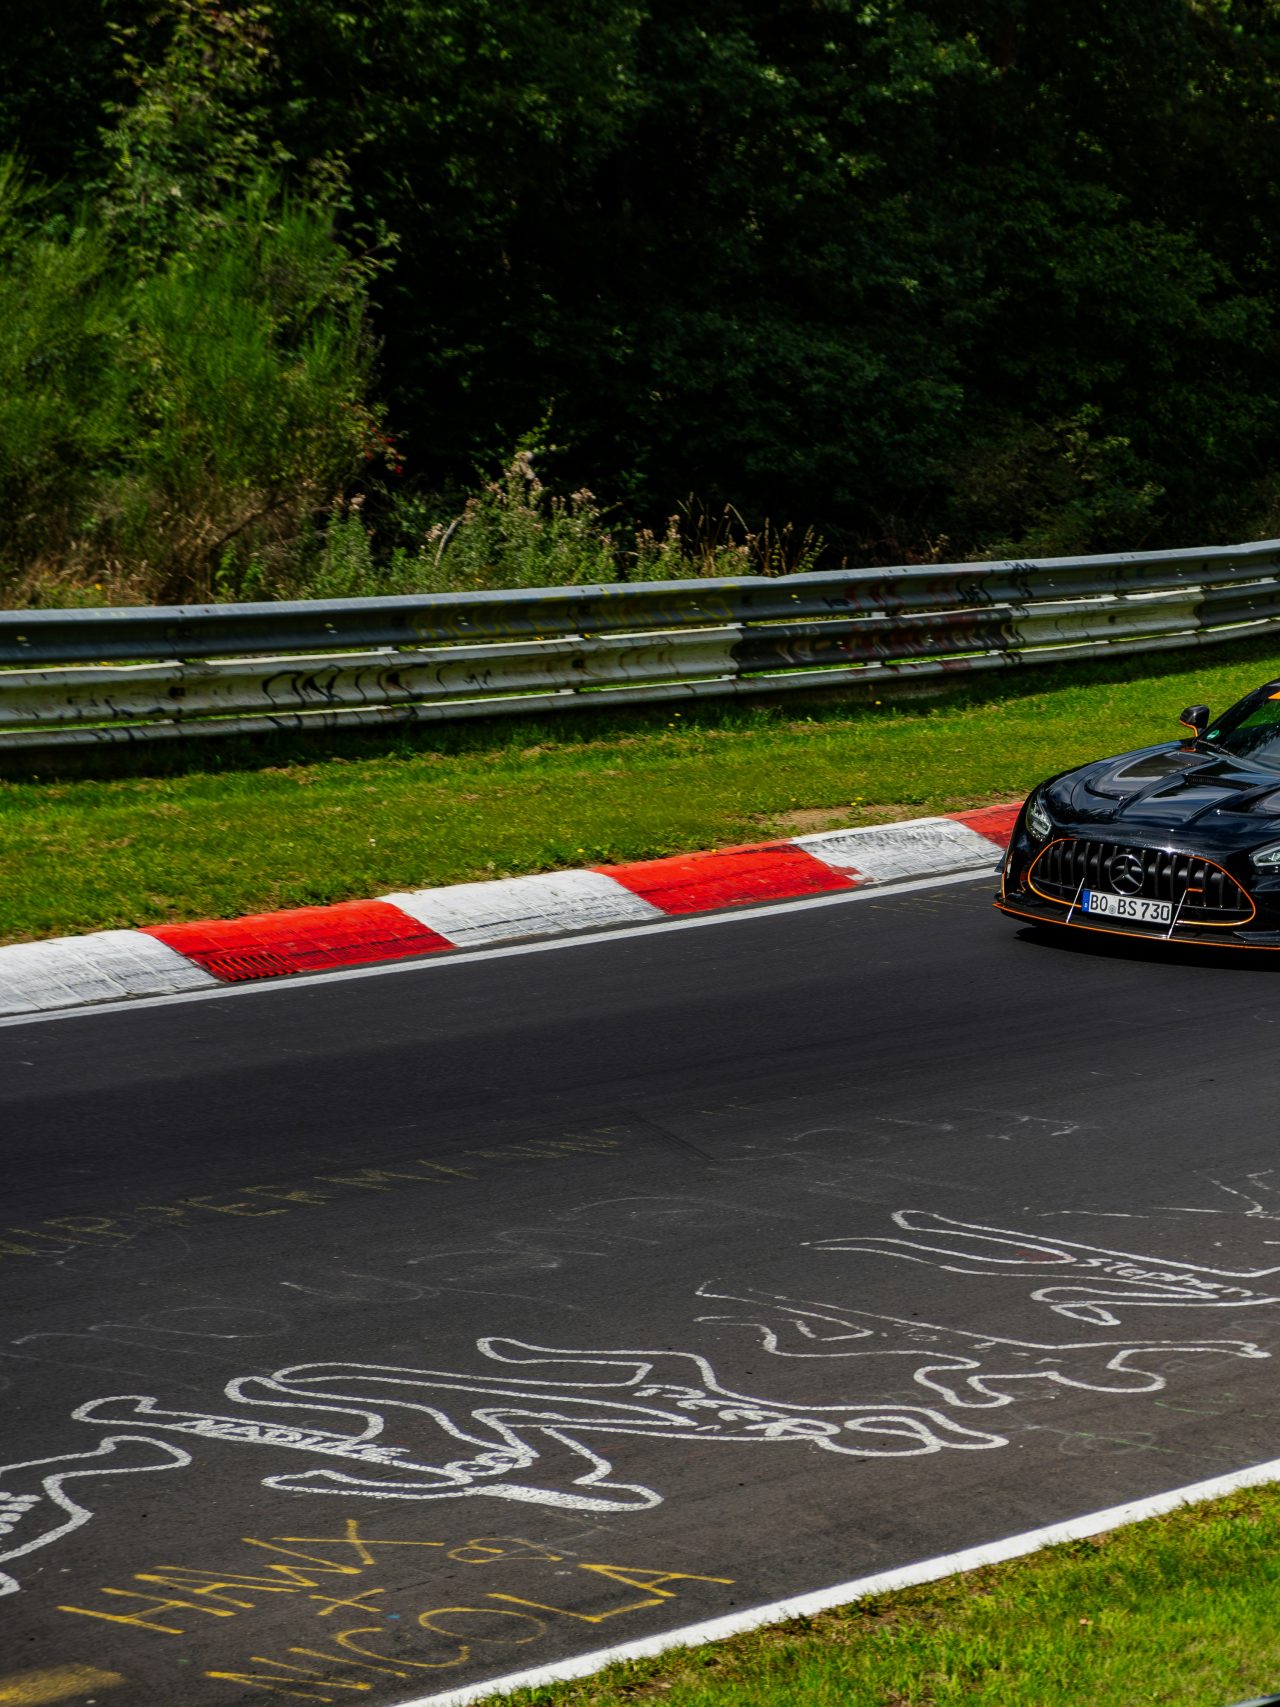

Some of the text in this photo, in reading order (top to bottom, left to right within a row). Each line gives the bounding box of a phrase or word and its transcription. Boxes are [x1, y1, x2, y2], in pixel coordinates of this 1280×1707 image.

[1090, 894, 1170, 921] BO BS 730
[204, 1563, 737, 1703] NICOLA
